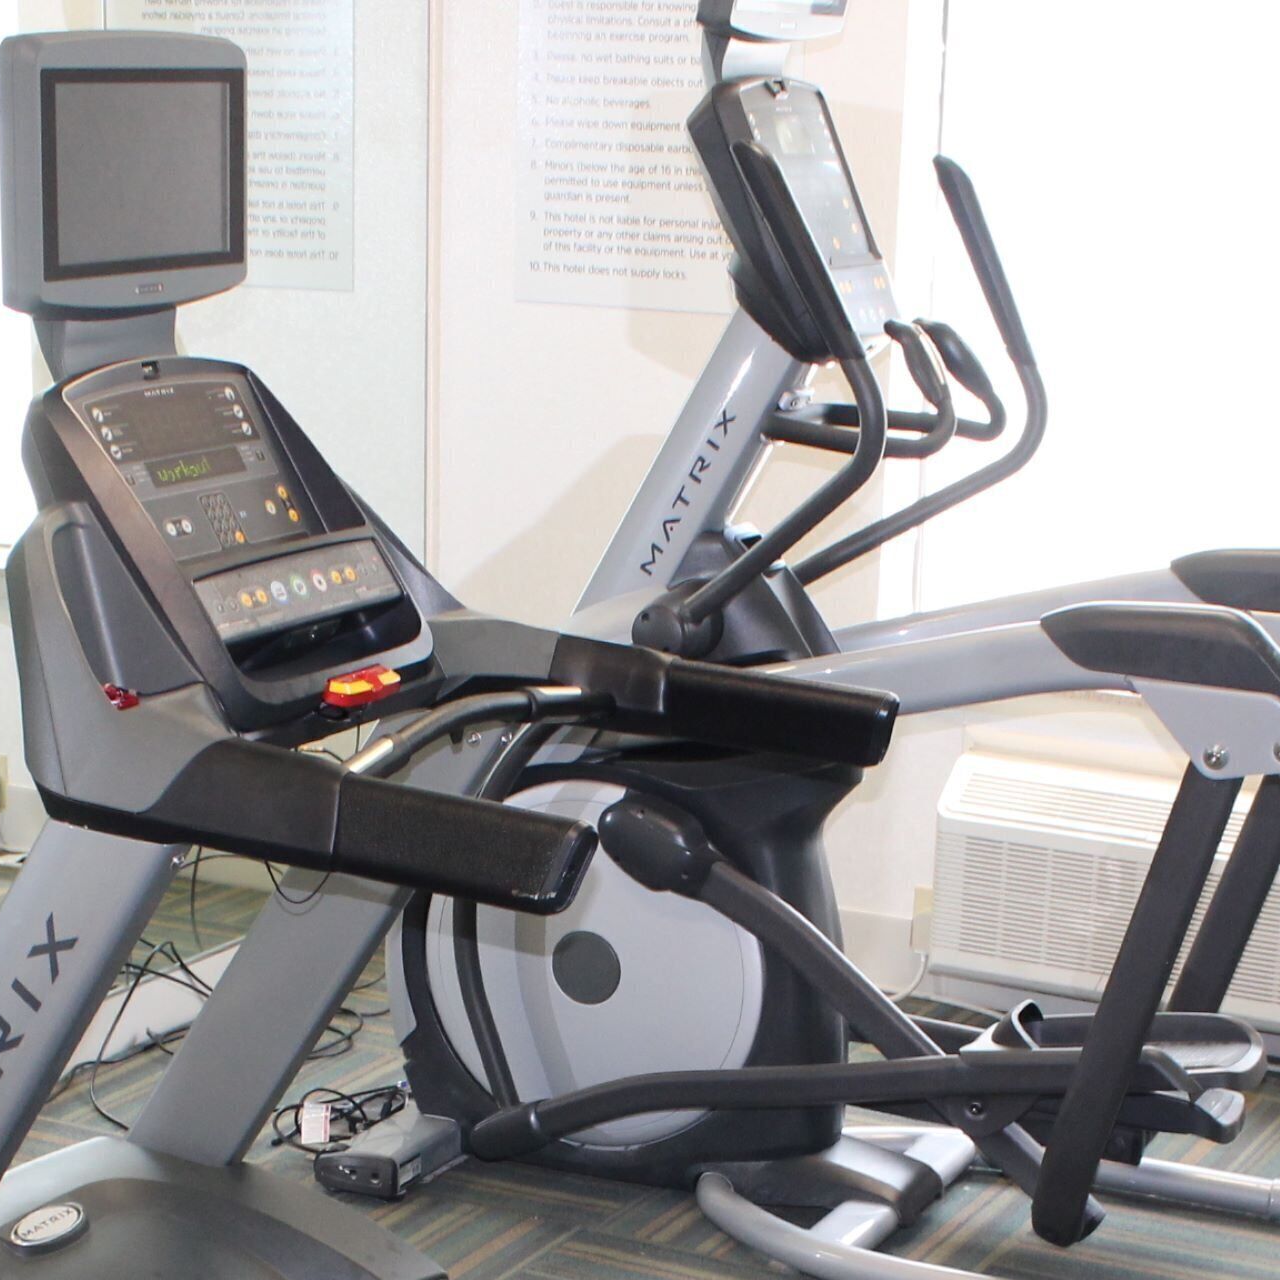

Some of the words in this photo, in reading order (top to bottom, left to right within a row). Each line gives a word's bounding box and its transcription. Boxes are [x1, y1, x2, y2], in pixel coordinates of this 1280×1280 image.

[615, 53, 651, 65] bathing
[650, 76, 685, 88] objects
[602, 118, 629, 129] down
[630, 120, 681, 132] equipment
[615, 141, 664, 154] disposable
[544, 159, 574, 171] Minors
[610, 160, 625, 172] the
[628, 165, 645, 176] age
[648, 163, 658, 175] of
[602, 180, 618, 189] use
[621, 180, 672, 193] equipment
[673, 181, 703, 192] unless
[544, 191, 584, 203] guardian
[544, 211, 562, 222] This
[564, 211, 587, 223] hotel
[599, 214, 615, 225] not
[617, 213, 641, 225] liable
[643, 215, 656, 226] for
[659, 216, 699, 231] personal
[543, 227, 582, 240] property
[597, 231, 614, 243] any
[616, 230, 640, 242] other
[643, 231, 671, 243] claims
[673, 233, 704, 246] arising
[707, 235, 723, 246] out
[555, 241, 571, 252] this
[573, 243, 601, 255] facility
[616, 245, 633, 256] the
[690, 249, 706, 260] Use
[543, 261, 560, 273] This
[562, 262, 585, 275] hotel
[588, 264, 610, 276] does
[612, 265, 628, 276] not
[630, 268, 660, 281] supply
[641, 409, 736, 575] MATRIX
[20, 1207, 74, 1239] MATRIX
